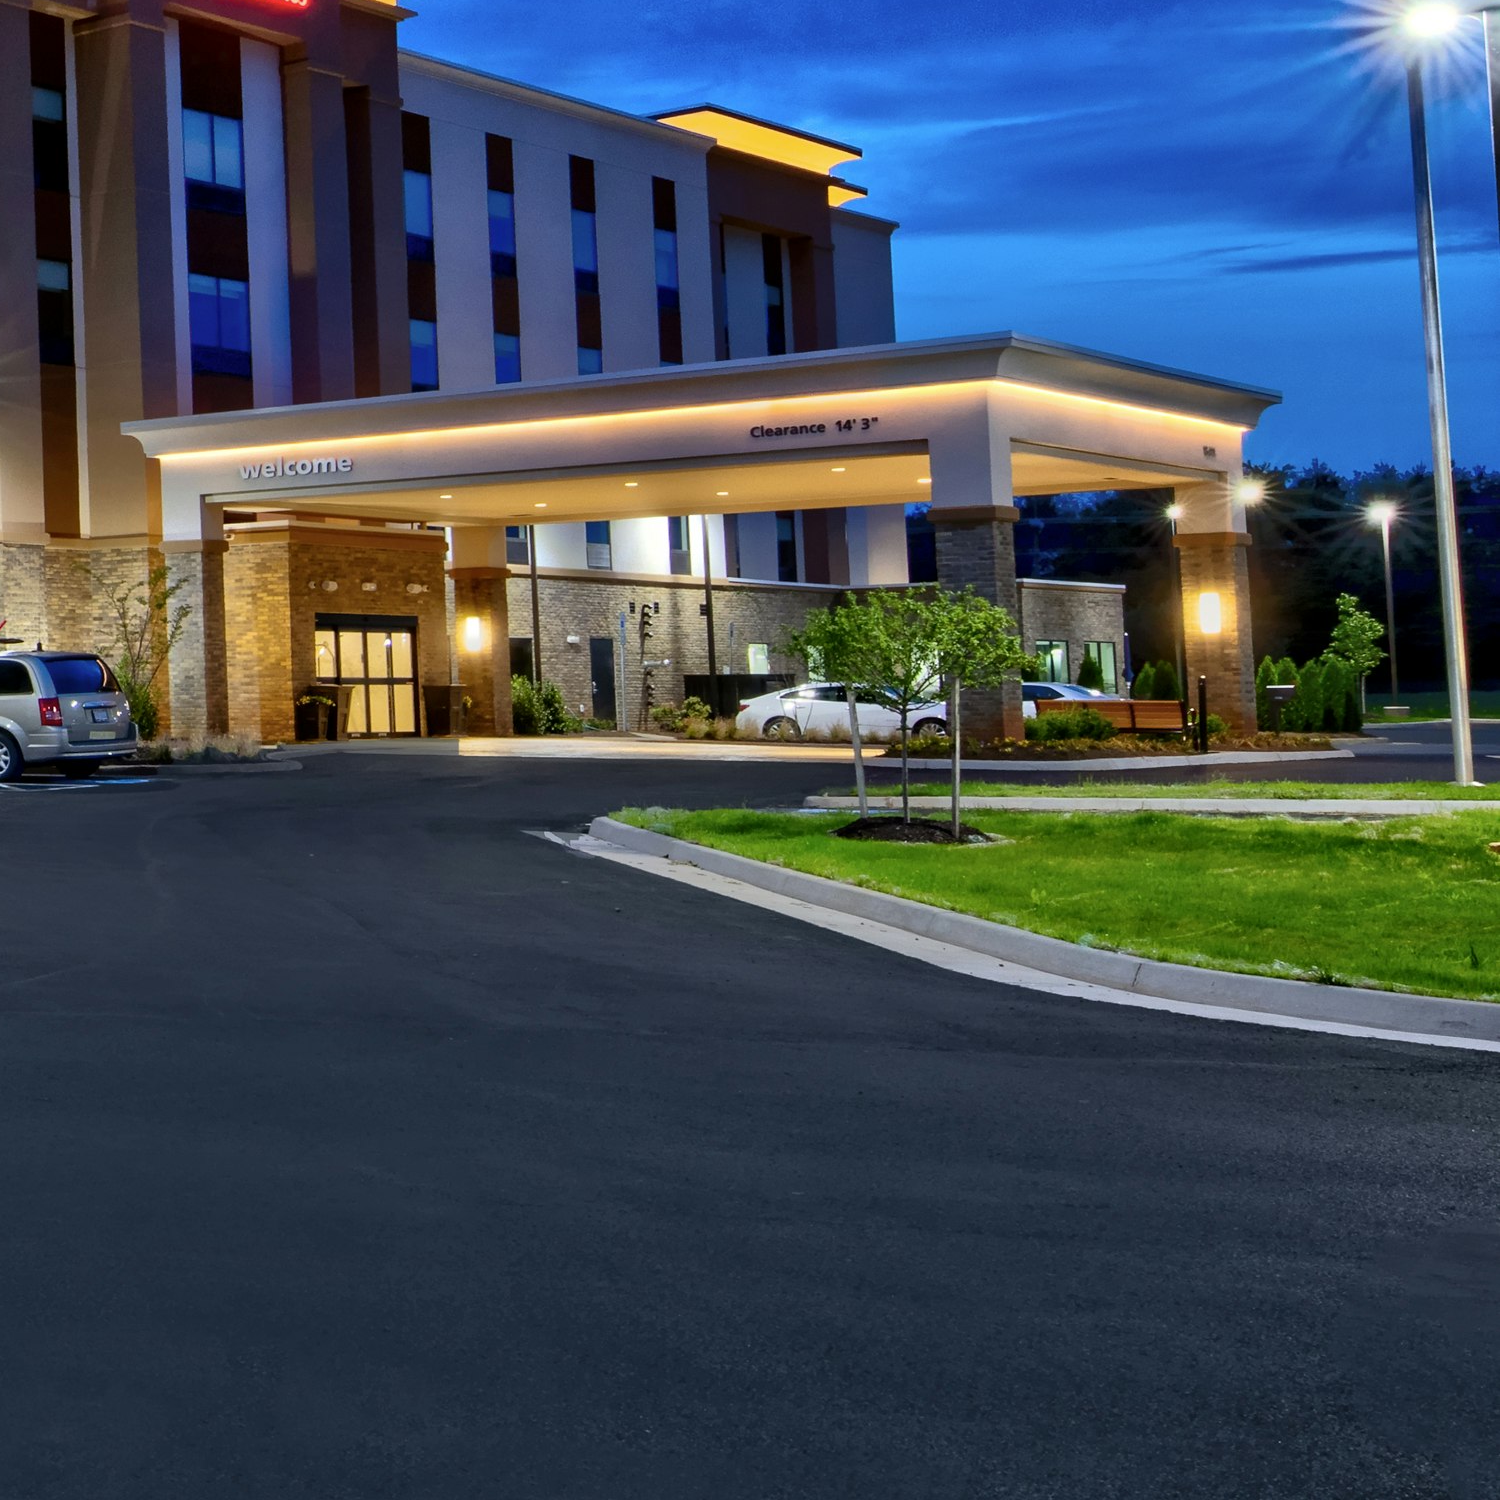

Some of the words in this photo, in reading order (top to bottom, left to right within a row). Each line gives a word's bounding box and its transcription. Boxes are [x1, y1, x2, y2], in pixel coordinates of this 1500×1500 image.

[750, 422, 826, 438] Clearance
[835, 418, 856, 433] 14'
[861, 416, 878, 431] 3"
[240, 456, 353, 480] welcome
